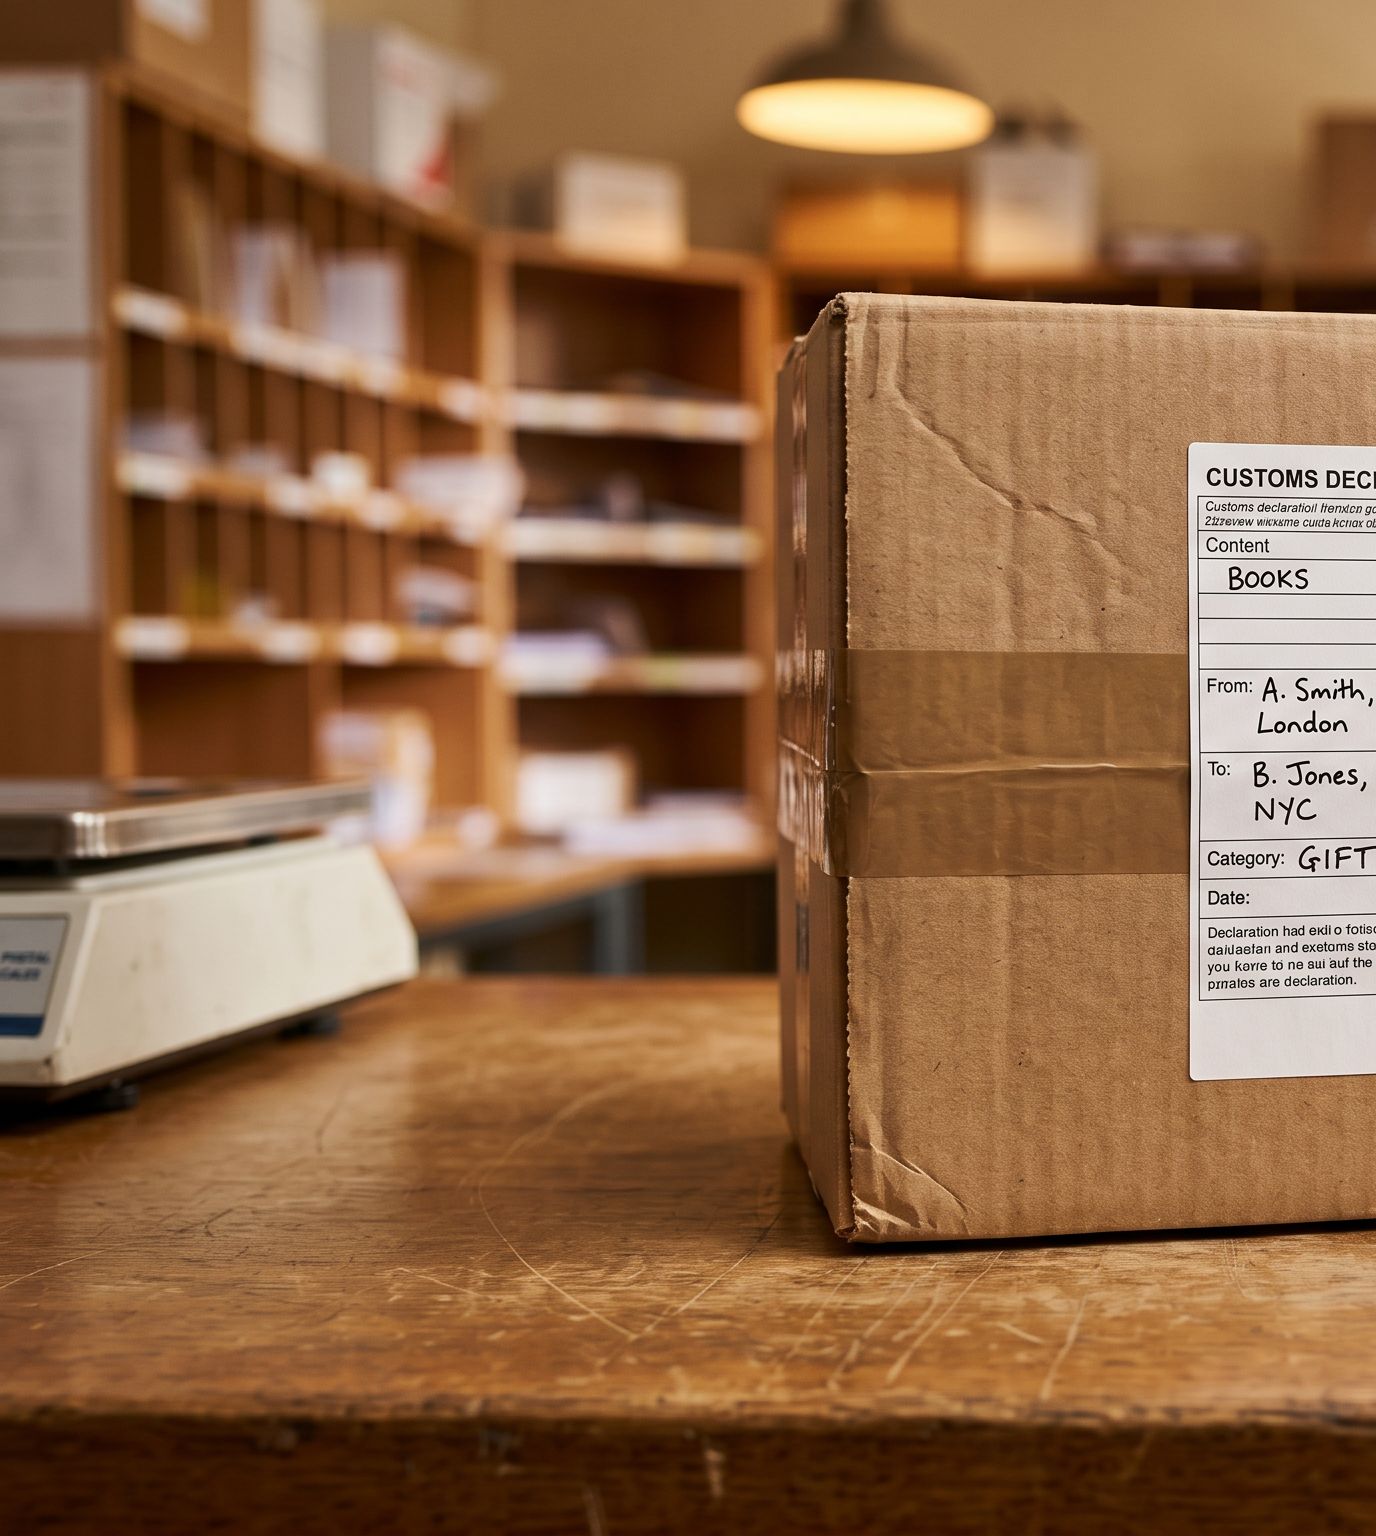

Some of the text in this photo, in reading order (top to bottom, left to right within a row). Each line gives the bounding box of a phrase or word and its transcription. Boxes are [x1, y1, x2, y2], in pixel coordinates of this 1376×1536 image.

[1206, 467, 1318, 489] CUSTOMS
[1206, 501, 1254, 511] Customs
[1206, 538, 1269, 553] Content
[1228, 566, 1308, 590] BOOKS
[1207, 679, 1253, 693] From:
[1262, 677, 1373, 706] A. Smith,
[1258, 711, 1348, 734] London
[1208, 762, 1230, 776] To:
[1254, 761, 1367, 791] B. Jones,
[1255, 798, 1317, 825] NYC
[1207, 851, 1284, 869] Category:
[1299, 846, 1376, 872] GIFT
[1208, 891, 1249, 905] Date:
[1208, 926, 1278, 938] Declaration
[1283, 926, 1304, 936] had
[1275, 942, 1298, 953] and
[1208, 963, 1229, 975] you
[1288, 961, 1303, 969] ne
[1353, 957, 1372, 967] the
[1260, 979, 1280, 987] are
[1284, 975, 1356, 986] declaration.
